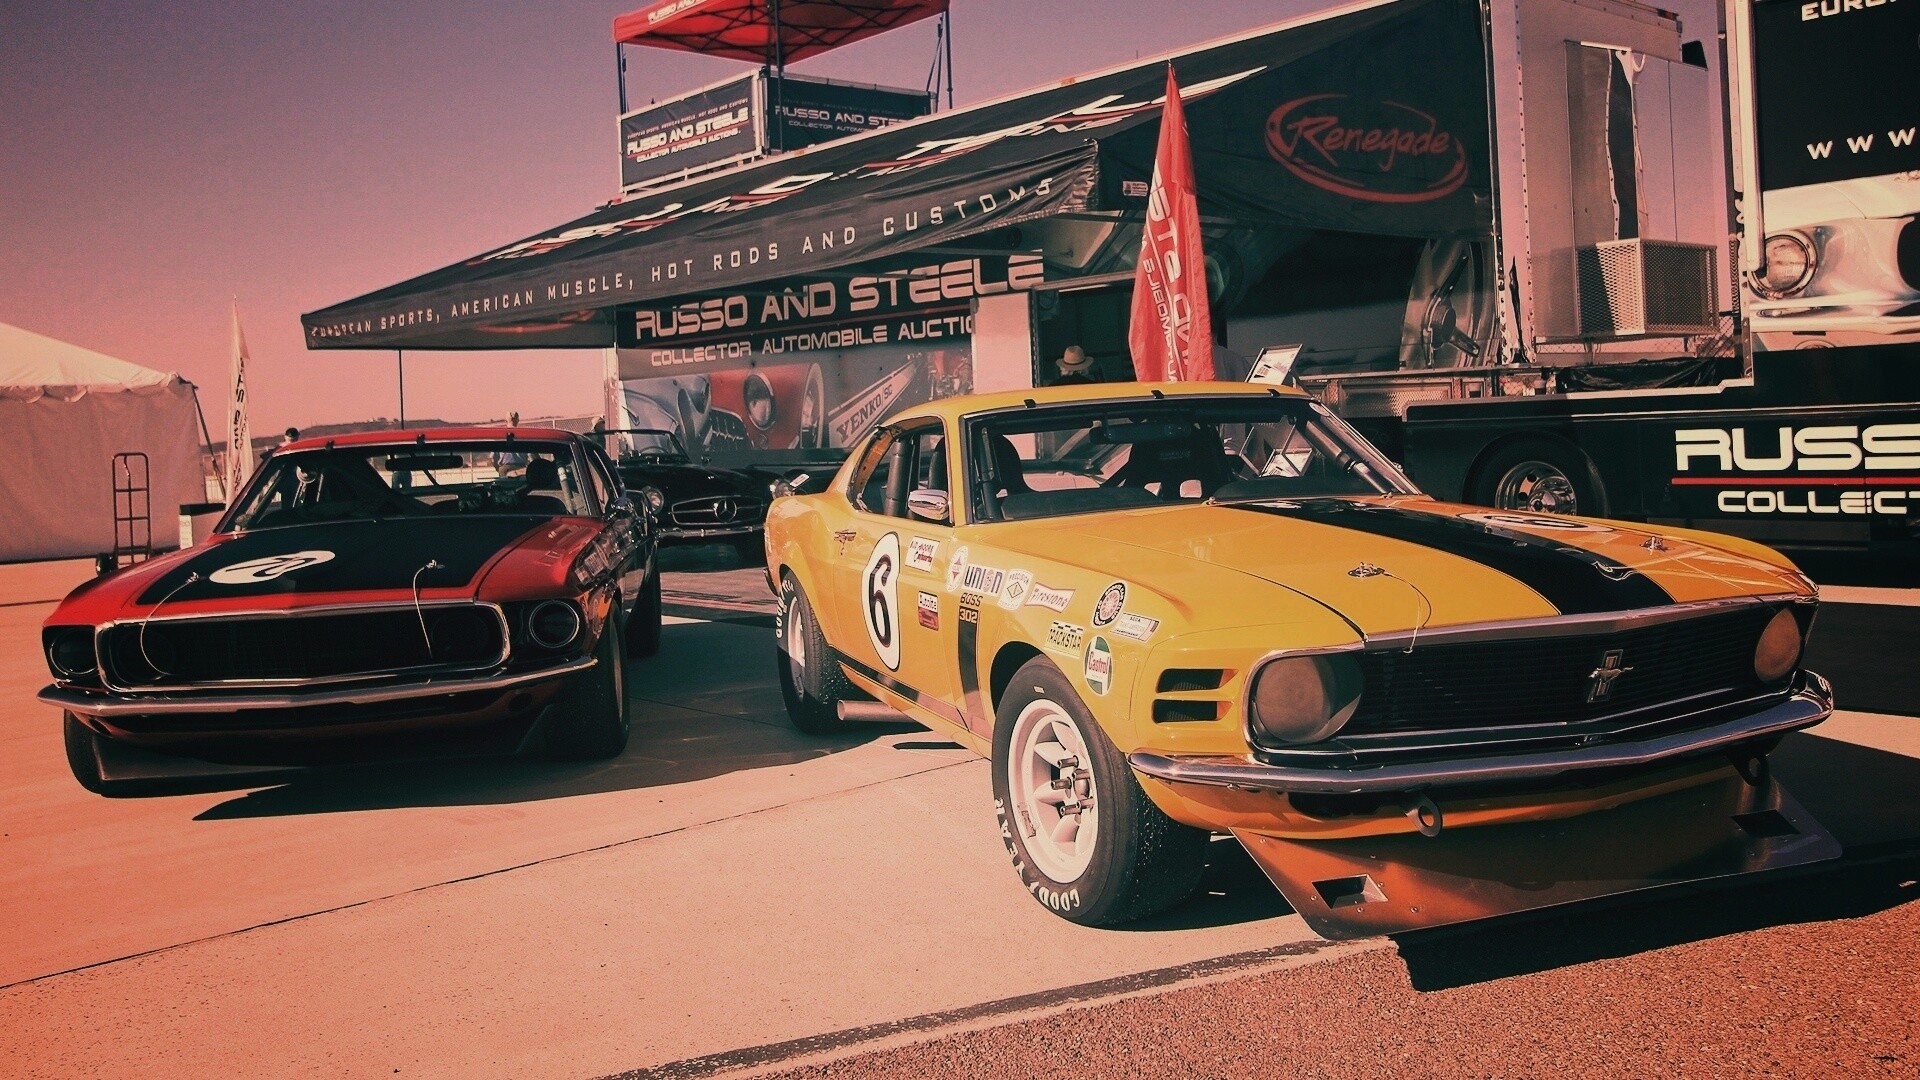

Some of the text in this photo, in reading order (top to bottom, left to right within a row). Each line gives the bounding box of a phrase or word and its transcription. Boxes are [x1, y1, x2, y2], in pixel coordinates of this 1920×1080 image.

[775, 105, 830, 121] RUSSO
[834, 112, 865, 124] AND
[788, 120, 833, 129] COLLECTOR
[627, 133, 667, 155] RUSSO
[670, 124, 694, 144] AND
[696, 107, 749, 135] STEELE
[1288, 114, 1451, 172] Renegade
[381, 309, 441, 330] SPORTS,
[451, 289, 534, 318] AMERICAN
[547, 272, 634, 301] MUSCLE,
[651, 259, 693, 283] HOT
[713, 243, 778, 271] RODS
[802, 226, 856, 254] AND
[882, 177, 1053, 237] CUSTOMS
[636, 249, 1044, 340] RUSSO AND STEELE
[651, 341, 752, 367] COLLECTOR
[762, 324, 888, 356] AUTOMOBILE
[868, 554, 892, 648] 6
[960, 592, 984, 607] BOSS
[1032, 587, 1068, 608] Firestone
[959, 609, 979, 624] 302
[1047, 628, 1082, 650] TRACKSTAR
[1088, 650, 1110, 675] Castrol
